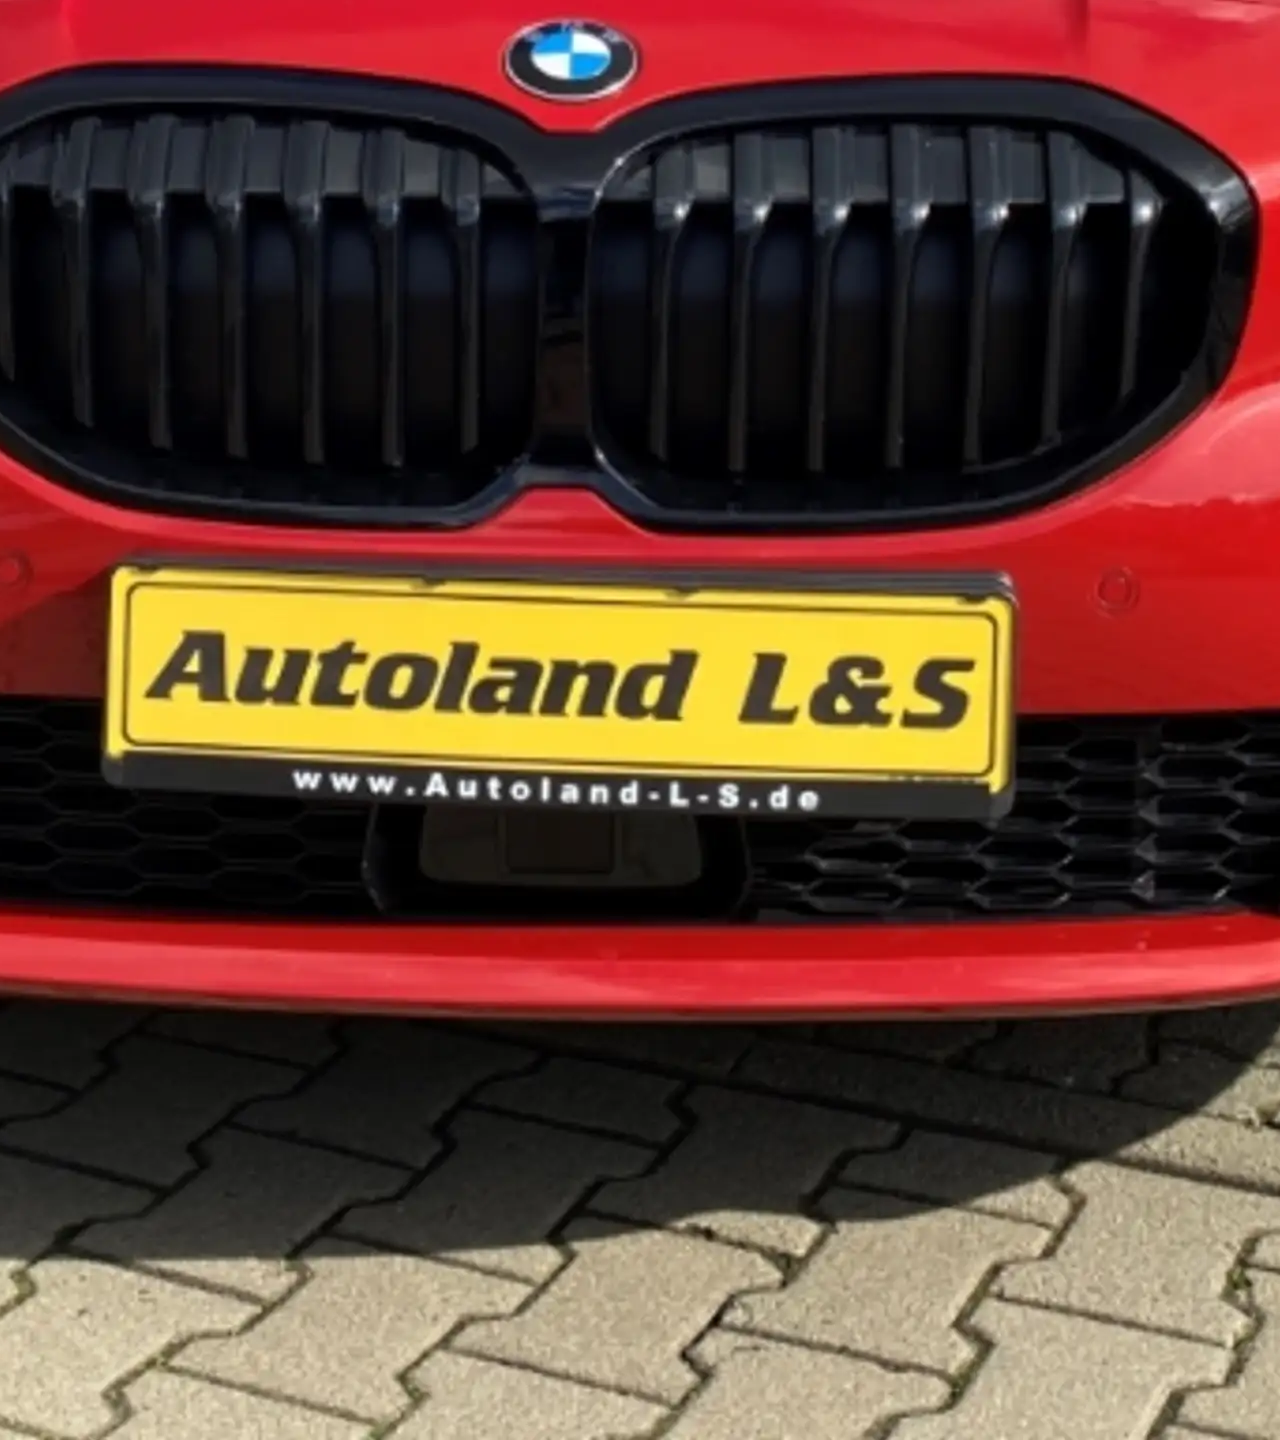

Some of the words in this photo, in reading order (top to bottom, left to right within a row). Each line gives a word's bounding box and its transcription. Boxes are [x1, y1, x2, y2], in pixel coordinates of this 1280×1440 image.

[146, 630, 699, 722] Autoland
[738, 652, 976, 730] L&S
[291, 769, 821, 812] www.Autoland-L-S.de
